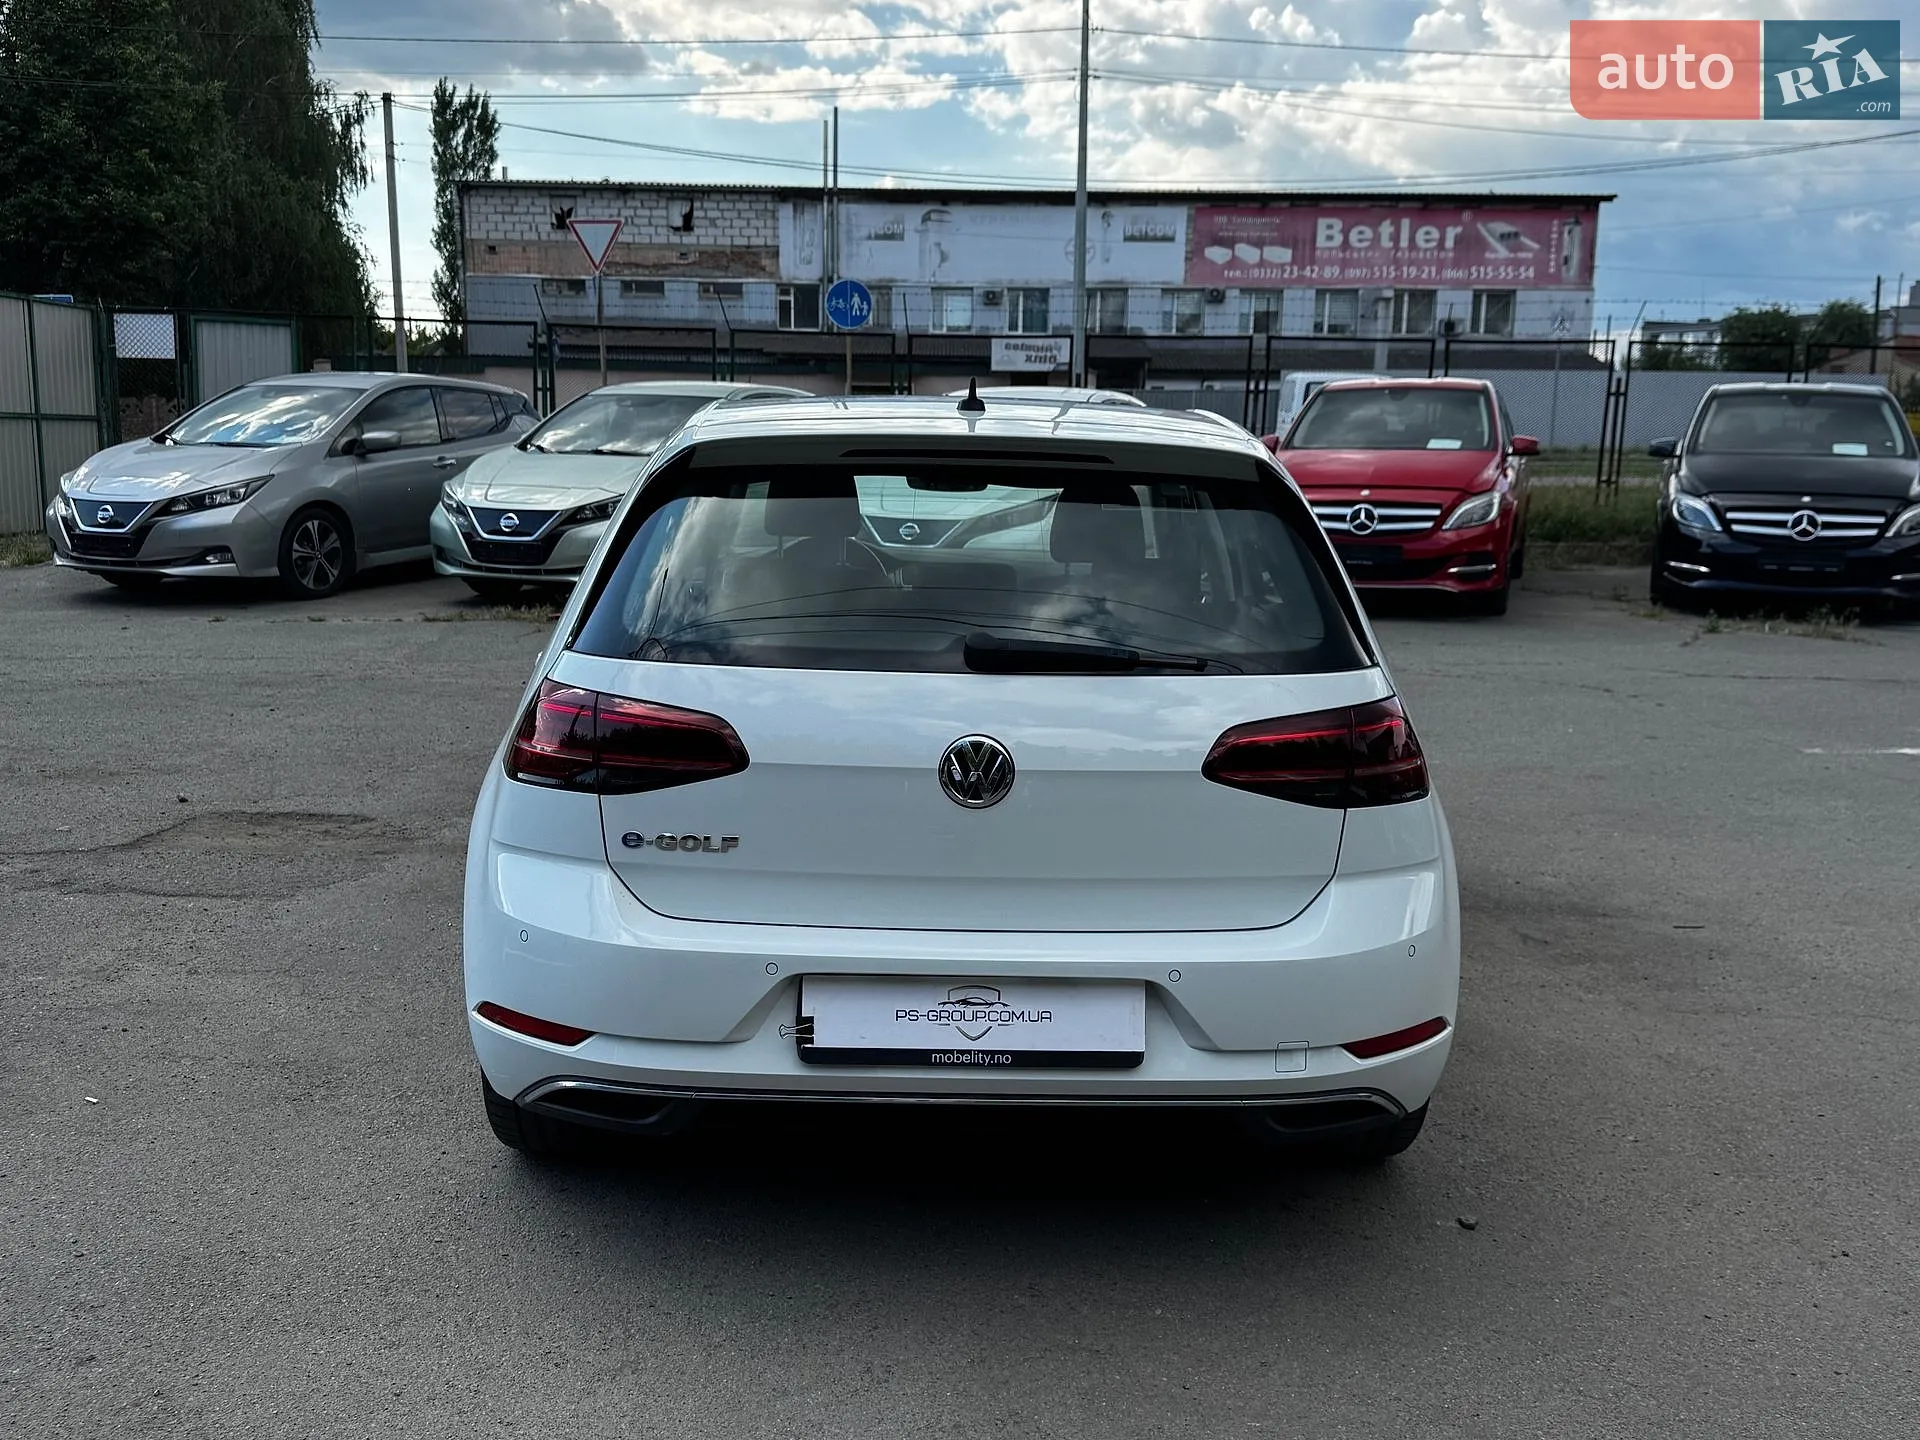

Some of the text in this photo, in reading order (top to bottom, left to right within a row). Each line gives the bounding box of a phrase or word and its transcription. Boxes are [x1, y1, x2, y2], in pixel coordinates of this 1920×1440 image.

[1316, 217, 1465, 249] Betler
[621, 830, 740, 853] e-GOLF
[895, 1009, 1053, 1023] PS-GROUP.COM.UA
[931, 1050, 1012, 1066] mobelity.no
